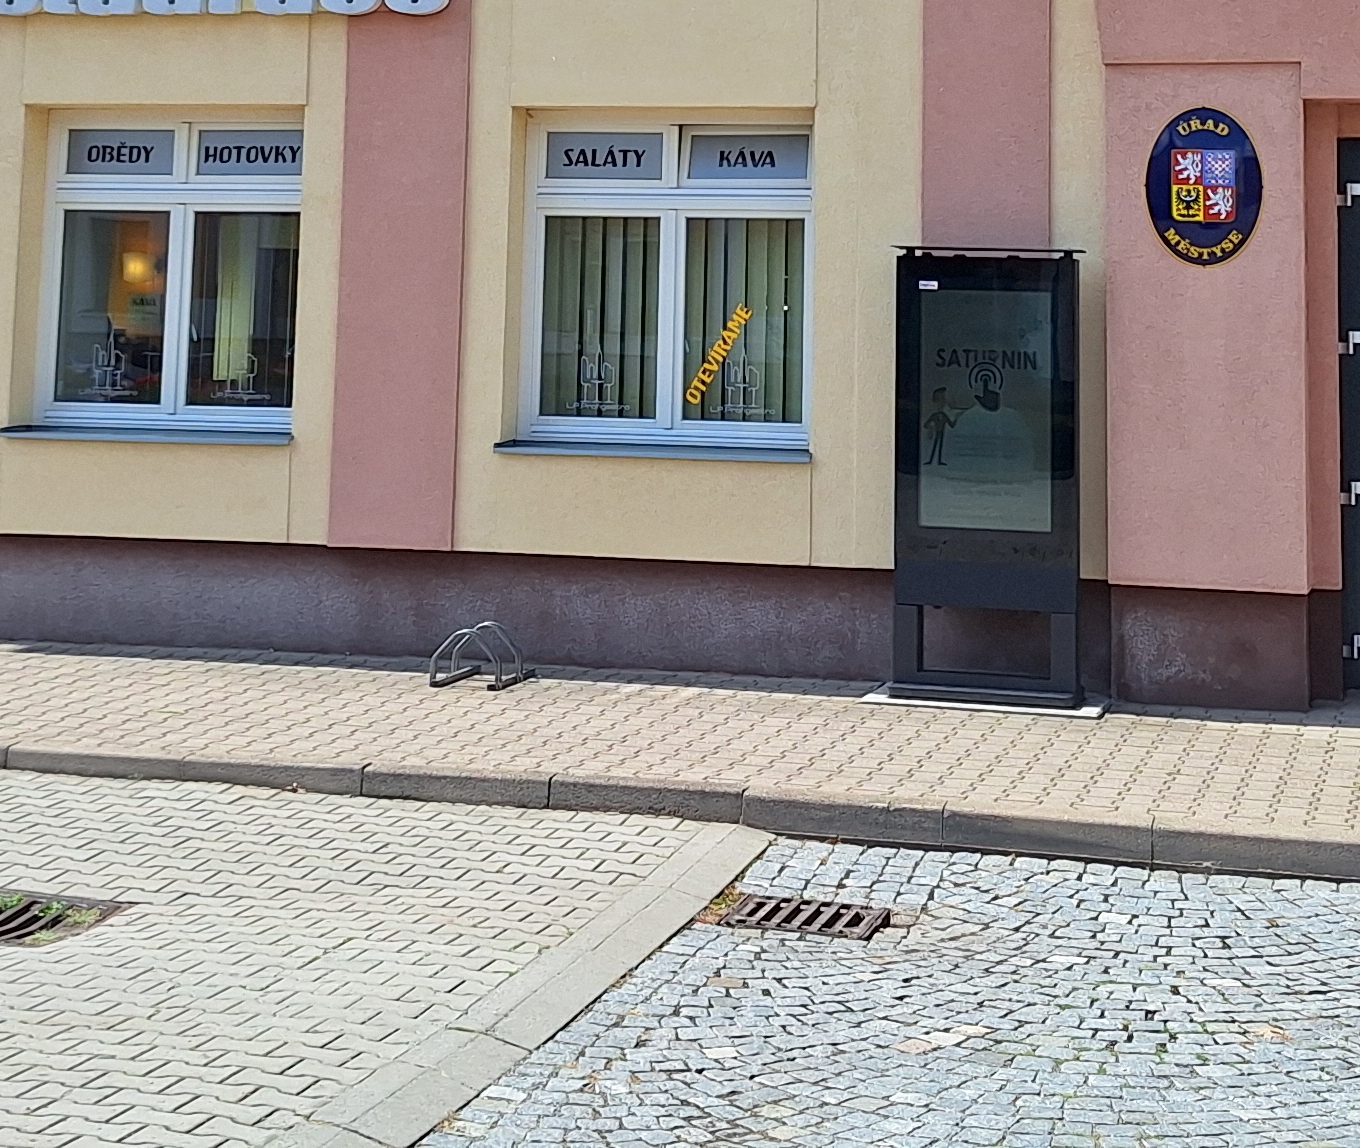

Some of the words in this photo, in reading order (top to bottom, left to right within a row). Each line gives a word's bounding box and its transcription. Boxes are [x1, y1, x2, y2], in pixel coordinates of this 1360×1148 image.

[1176, 116, 1230, 136] ÚŘAD
[87, 141, 154, 164] OBĚDY
[204, 145, 302, 164] HOTOVKY
[563, 145, 646, 167] SALÁTY
[718, 146, 776, 168] KÁVA
[1164, 227, 1243, 260] MĚSTYSE
